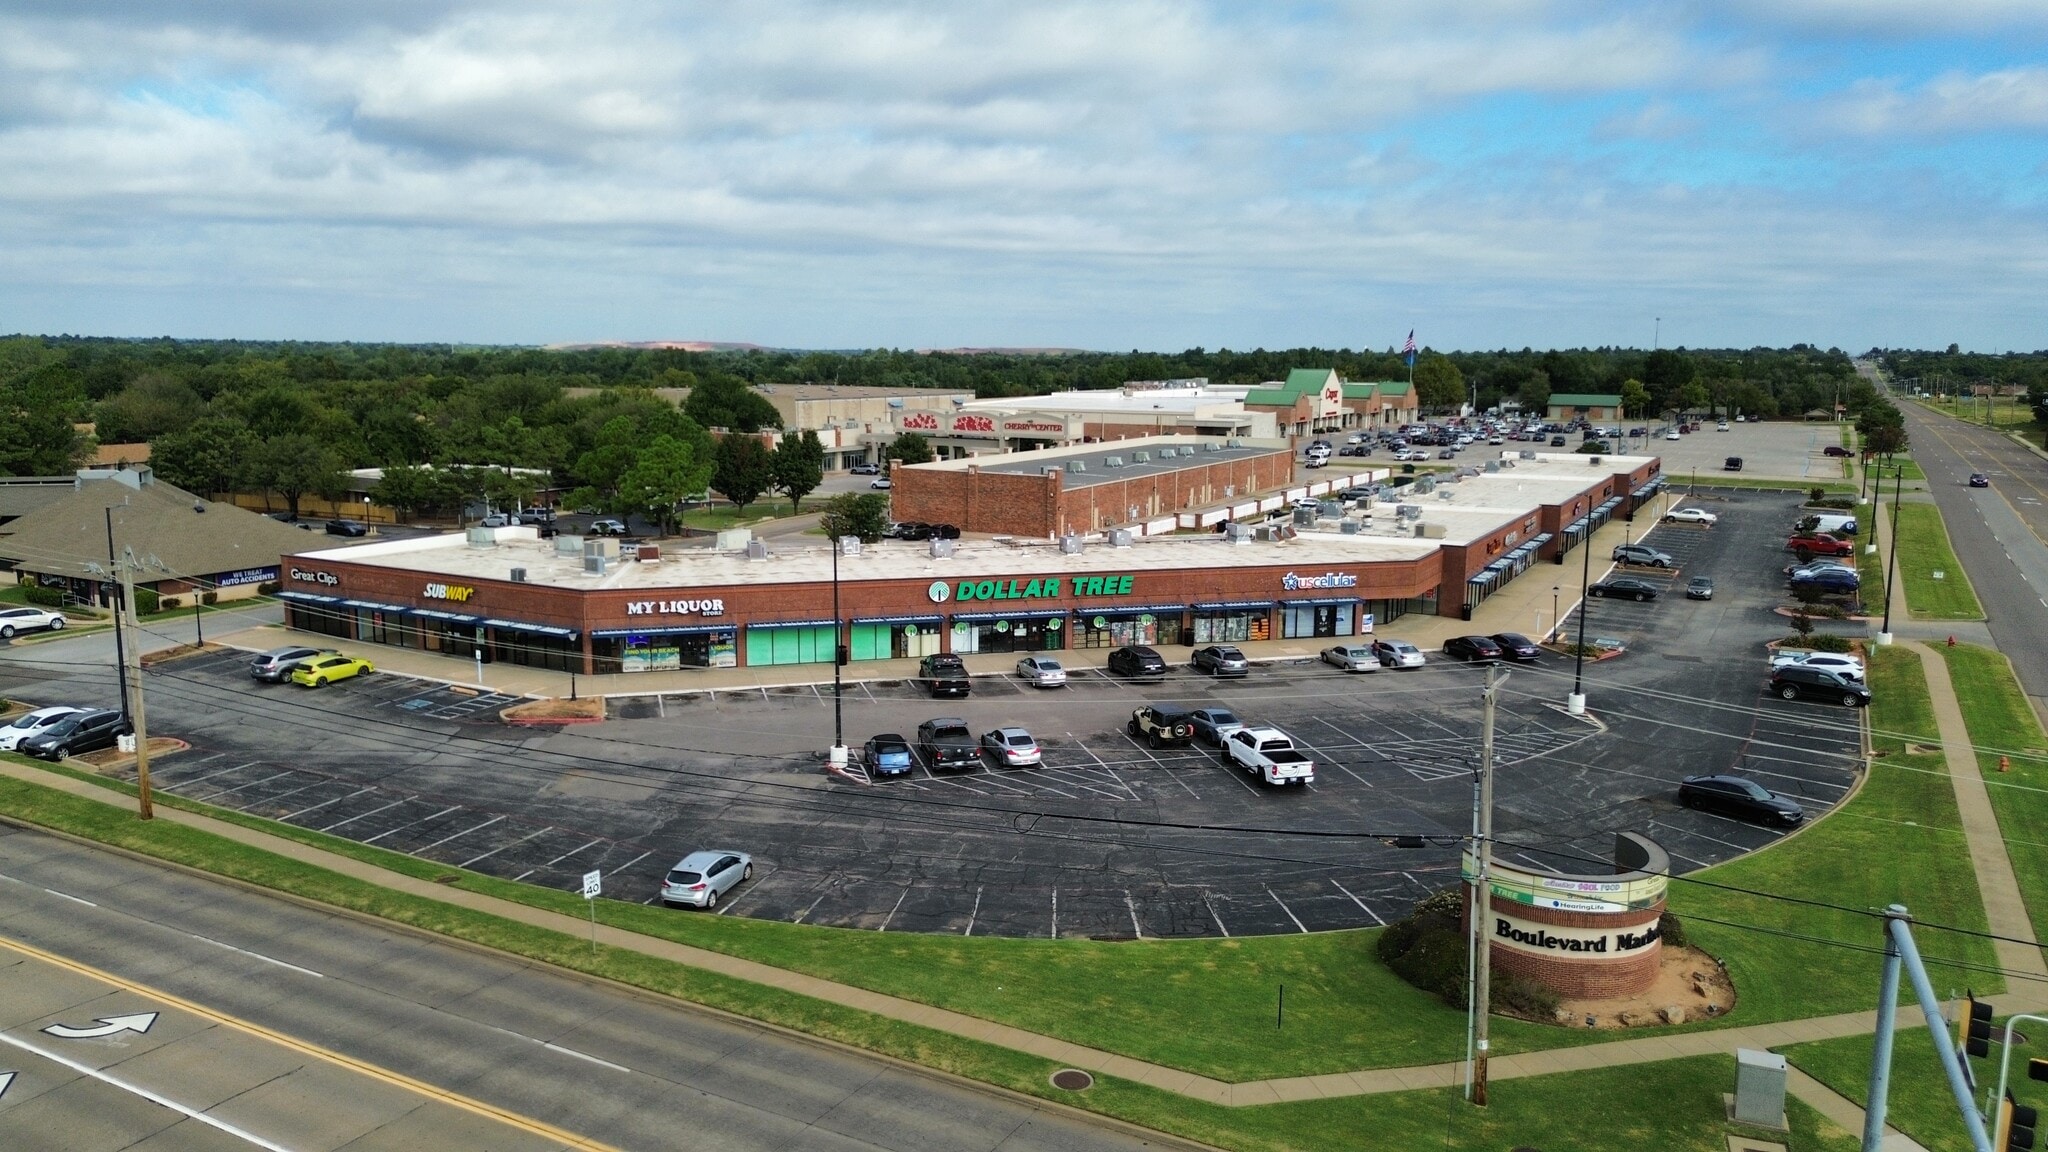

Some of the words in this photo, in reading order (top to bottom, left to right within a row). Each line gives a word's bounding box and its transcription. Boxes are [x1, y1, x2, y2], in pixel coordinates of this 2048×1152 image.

[1004, 422, 1031, 431] CHERRY
[1035, 423, 1063, 432] CENTER
[221, 577, 240, 586] AUTO
[240, 572, 275, 584] ACCIDENTS
[244, 568, 263, 577] TREAT
[290, 568, 315, 582] Great
[317, 571, 338, 586] Clips
[423, 583, 474, 601] SUBWAY
[956, 578, 1061, 601] DOLLAR
[1071, 575, 1135, 597] TREE
[627, 601, 656, 615] MY
[659, 599, 724, 615] LIQUOR
[586, 883, 599, 894] 40
[1496, 887, 1519, 900] TREE
[1559, 902, 1605, 911] HearingLife
[1495, 918, 1607, 952] Boulevard
